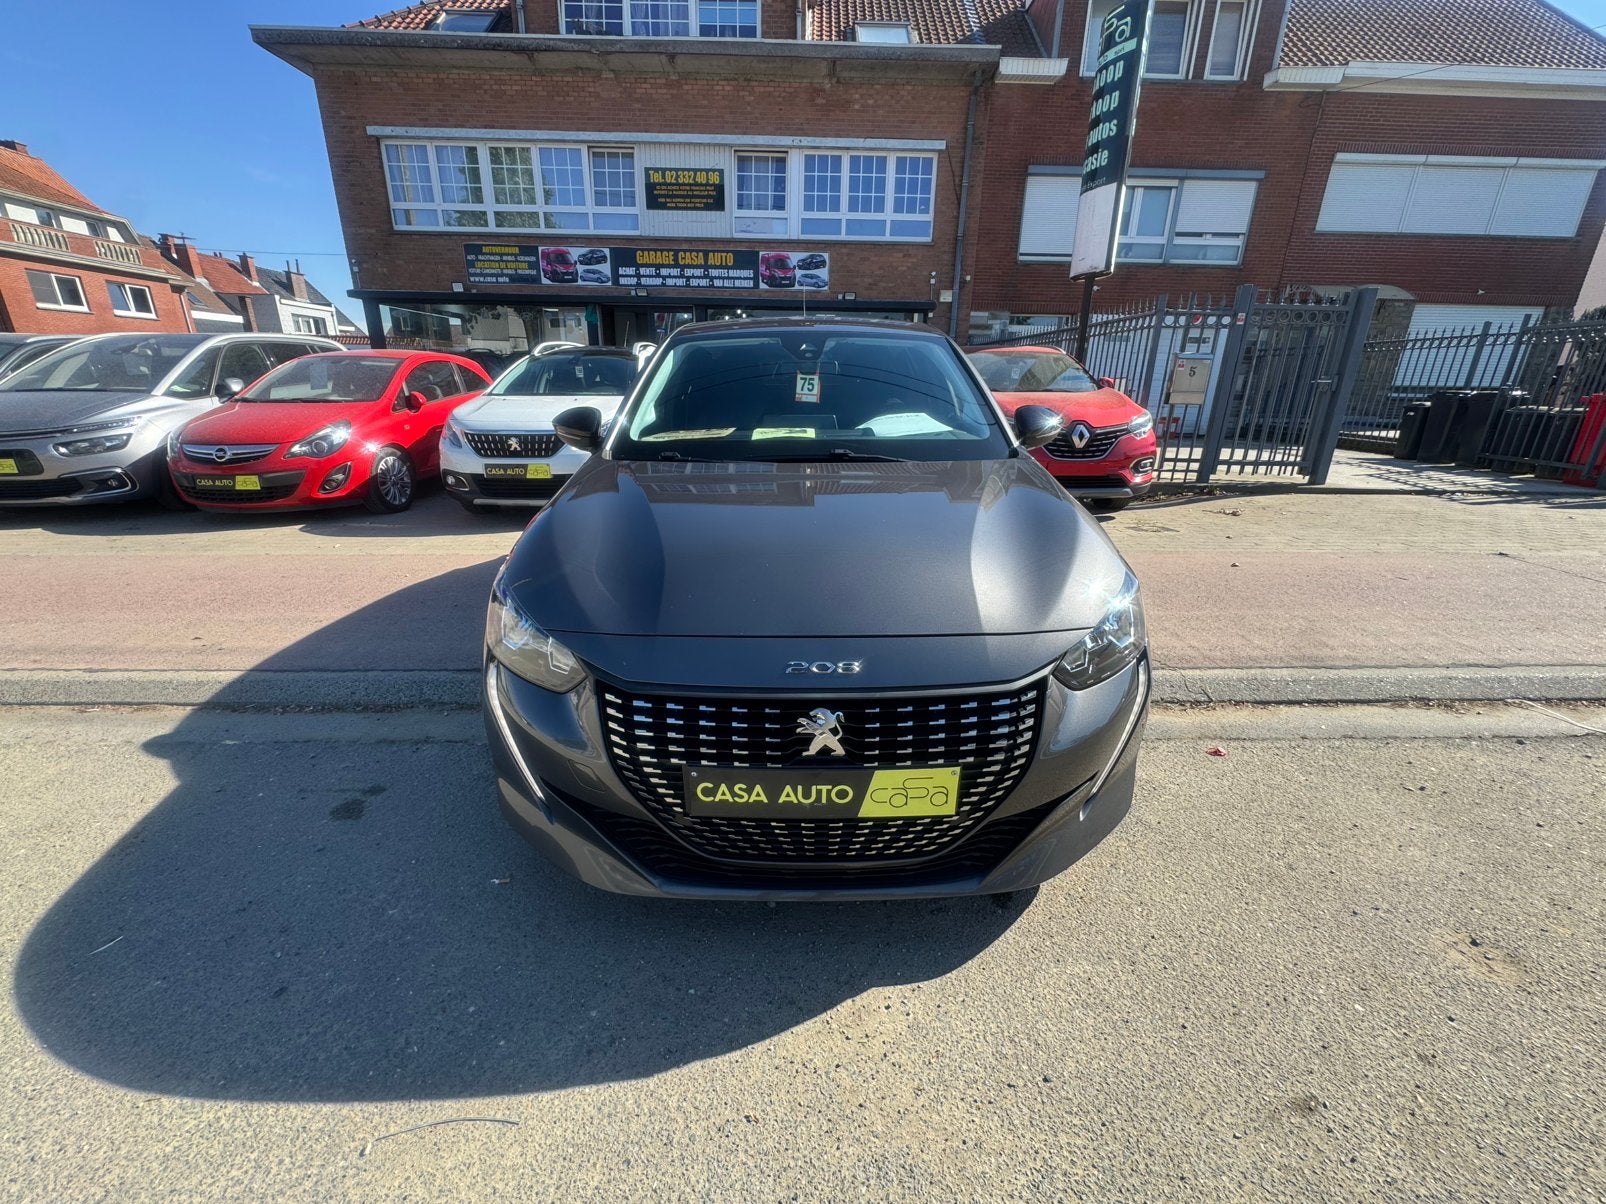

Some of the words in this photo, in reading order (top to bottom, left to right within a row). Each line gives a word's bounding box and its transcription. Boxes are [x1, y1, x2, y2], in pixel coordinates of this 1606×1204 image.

[1093, 59, 1123, 93] koop
[1089, 90, 1119, 120] koop
[649, 171, 664, 183] Tel.
[665, 171, 677, 183] 02
[678, 171, 695, 184] 332
[696, 172, 707, 184] 40
[708, 172, 720, 184] 96
[636, 250, 675, 265] GARAGE
[678, 251, 705, 265] CASA
[708, 252, 734, 266] AUTO
[619, 267, 636, 275] ACHAT
[660, 268, 680, 276] IMPORT
[708, 269, 728, 277] TOUTES
[729, 270, 754, 278] MARQUES
[619, 277, 637, 285] INKOOP
[665, 278, 686, 286] IMPORT
[690, 279, 710, 287] EXPORT
[713, 279, 723, 287] VAN
[1188, 366, 1198, 378] 5
[800, 377, 815, 392] 75
[486, 467, 505, 475] CASA
[506, 467, 525, 475] AUTO
[785, 661, 863, 674] 208
[696, 782, 769, 804] CASA
[778, 784, 854, 804] AUTO
